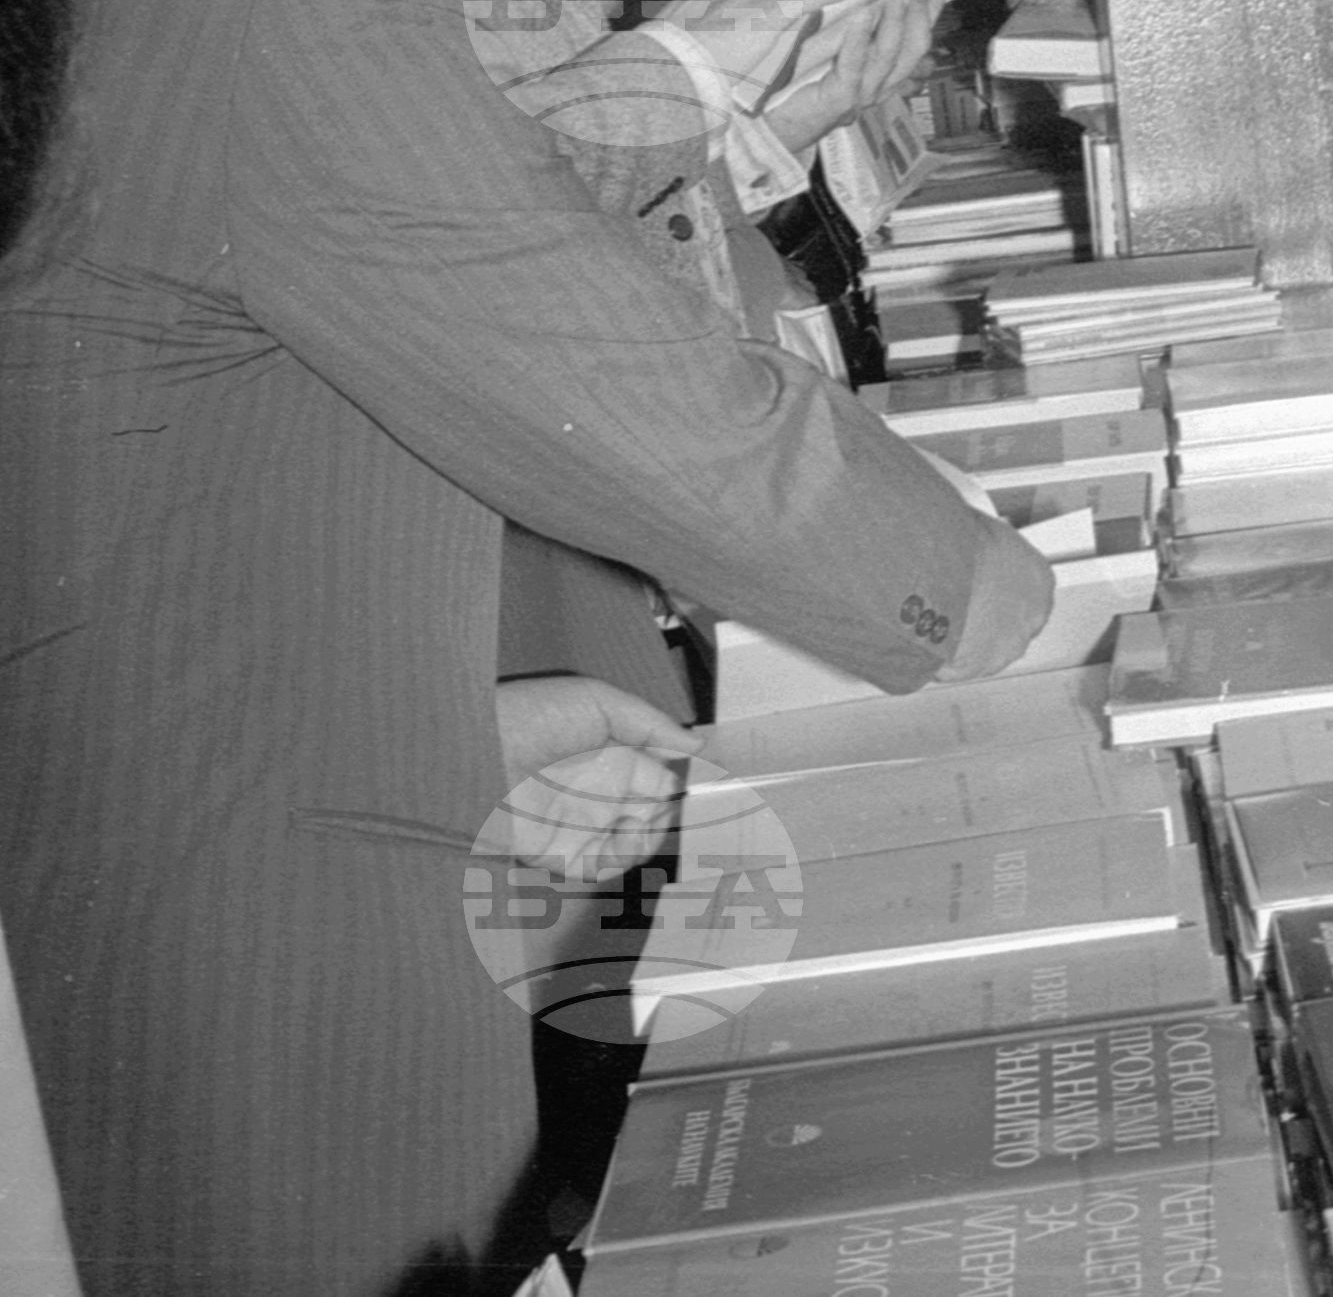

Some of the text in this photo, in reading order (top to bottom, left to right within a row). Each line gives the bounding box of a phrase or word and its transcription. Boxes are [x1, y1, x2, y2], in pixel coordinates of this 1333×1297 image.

[992, 1042, 1040, 1167] ЗНАНИЕТО
[1052, 1038, 1100, 1161] НА НАУКО-
[1109, 1026, 1160, 1153] ПРОБЛЕМИ
[1163, 1022, 1220, 1141] ОСНОВНИ
[900, 1219, 954, 1245] И
[1024, 1202, 1078, 1243] ЗА
